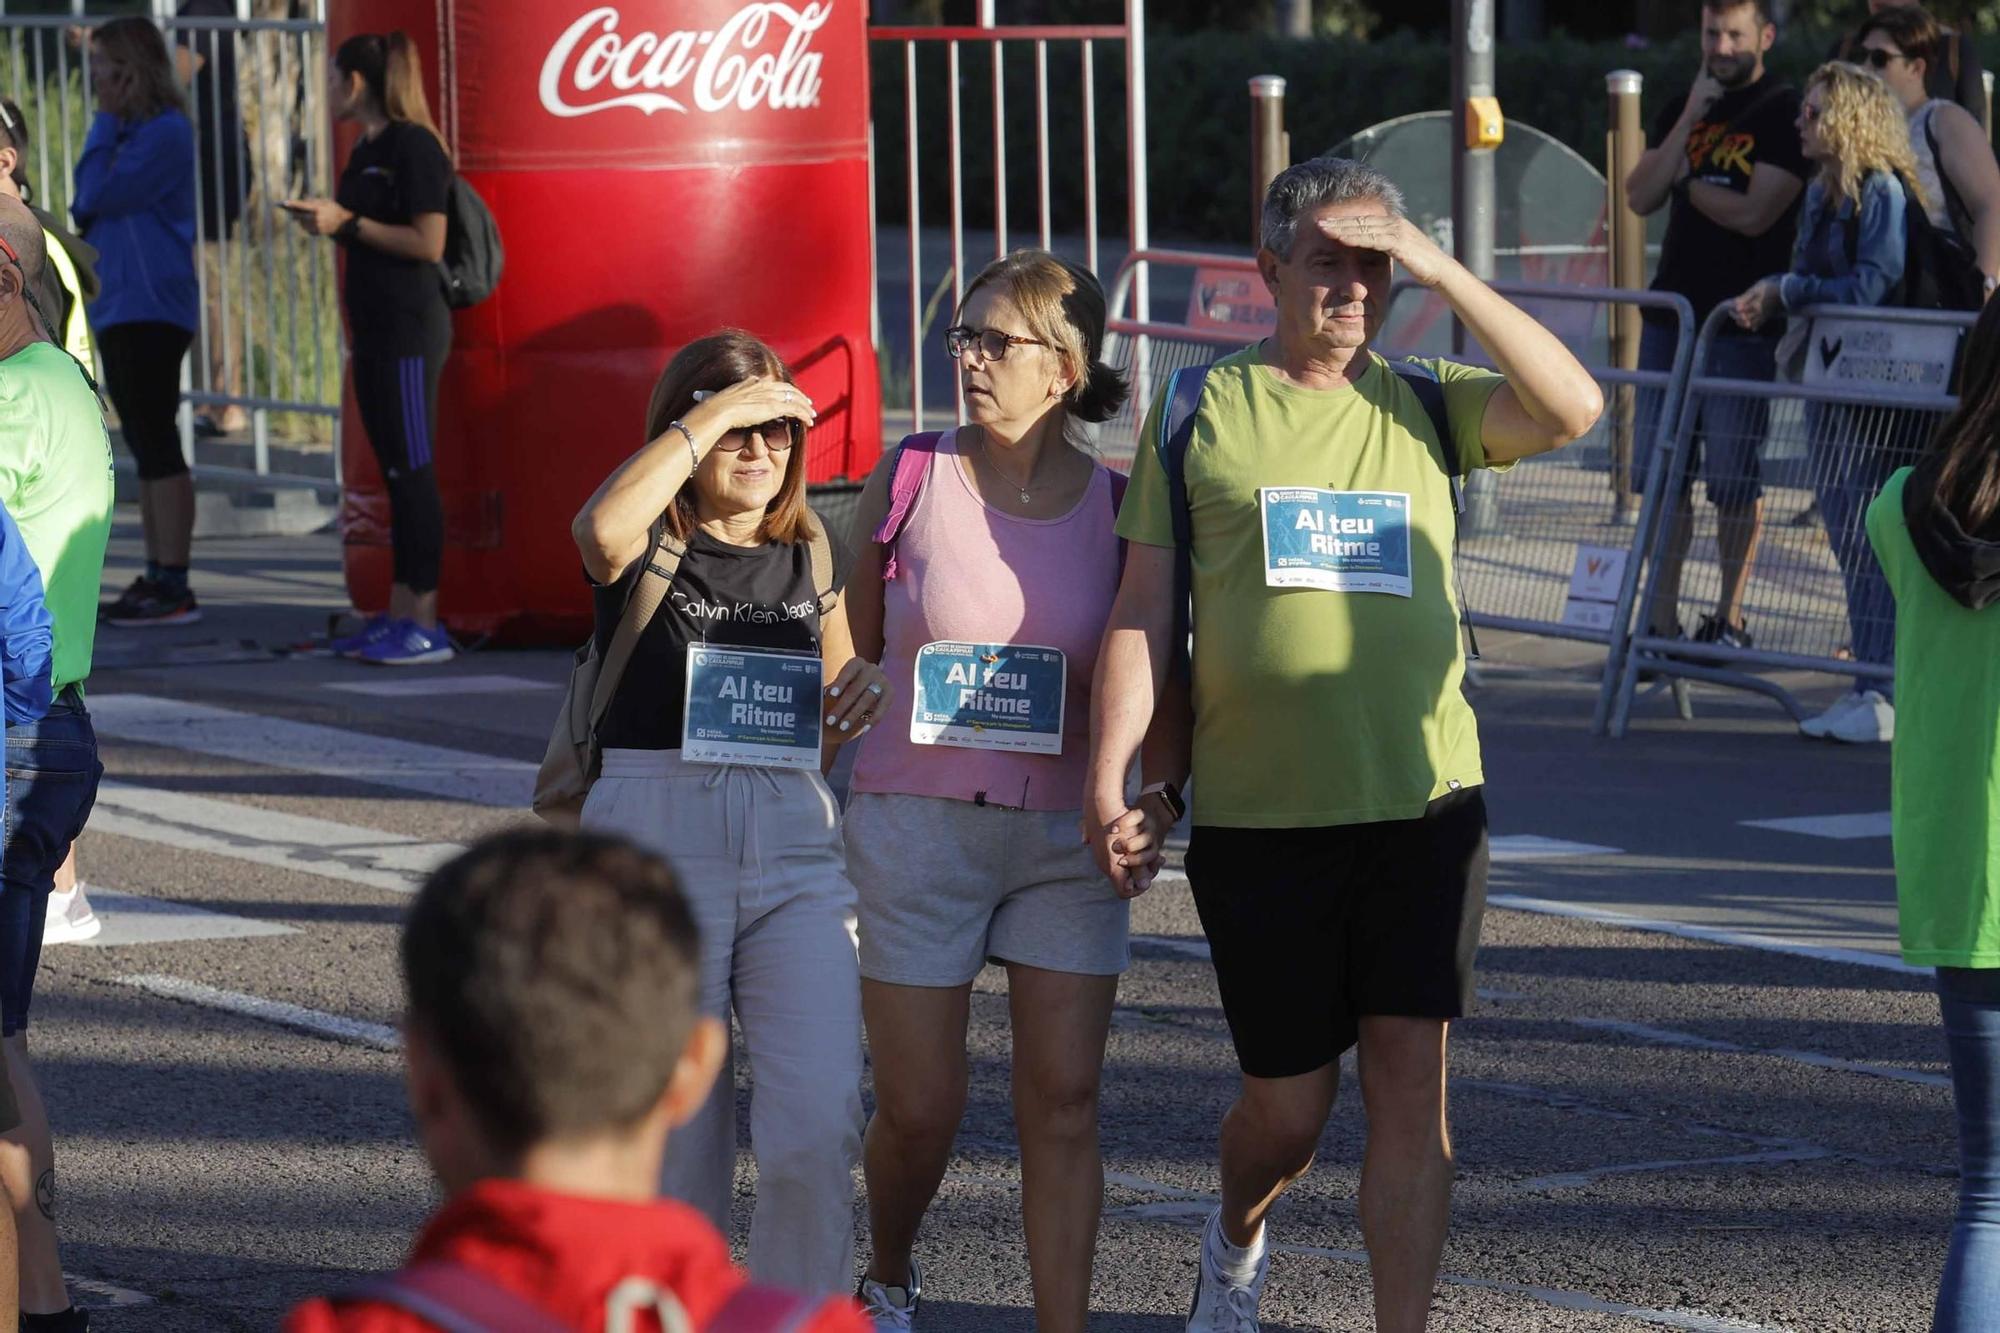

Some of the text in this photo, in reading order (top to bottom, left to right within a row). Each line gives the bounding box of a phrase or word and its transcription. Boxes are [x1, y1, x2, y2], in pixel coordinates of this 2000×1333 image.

[538, 1, 833, 117] Coca-Cola
[1295, 508, 1375, 535] Al teu
[1310, 533, 1381, 557] Ritme
[671, 592, 815, 624] Calvin Klein Jeans
[718, 675, 793, 704] Al teu
[945, 662, 1028, 691] Al teu
[960, 688, 1031, 714] Ritme
[731, 703, 796, 728] Ritme
